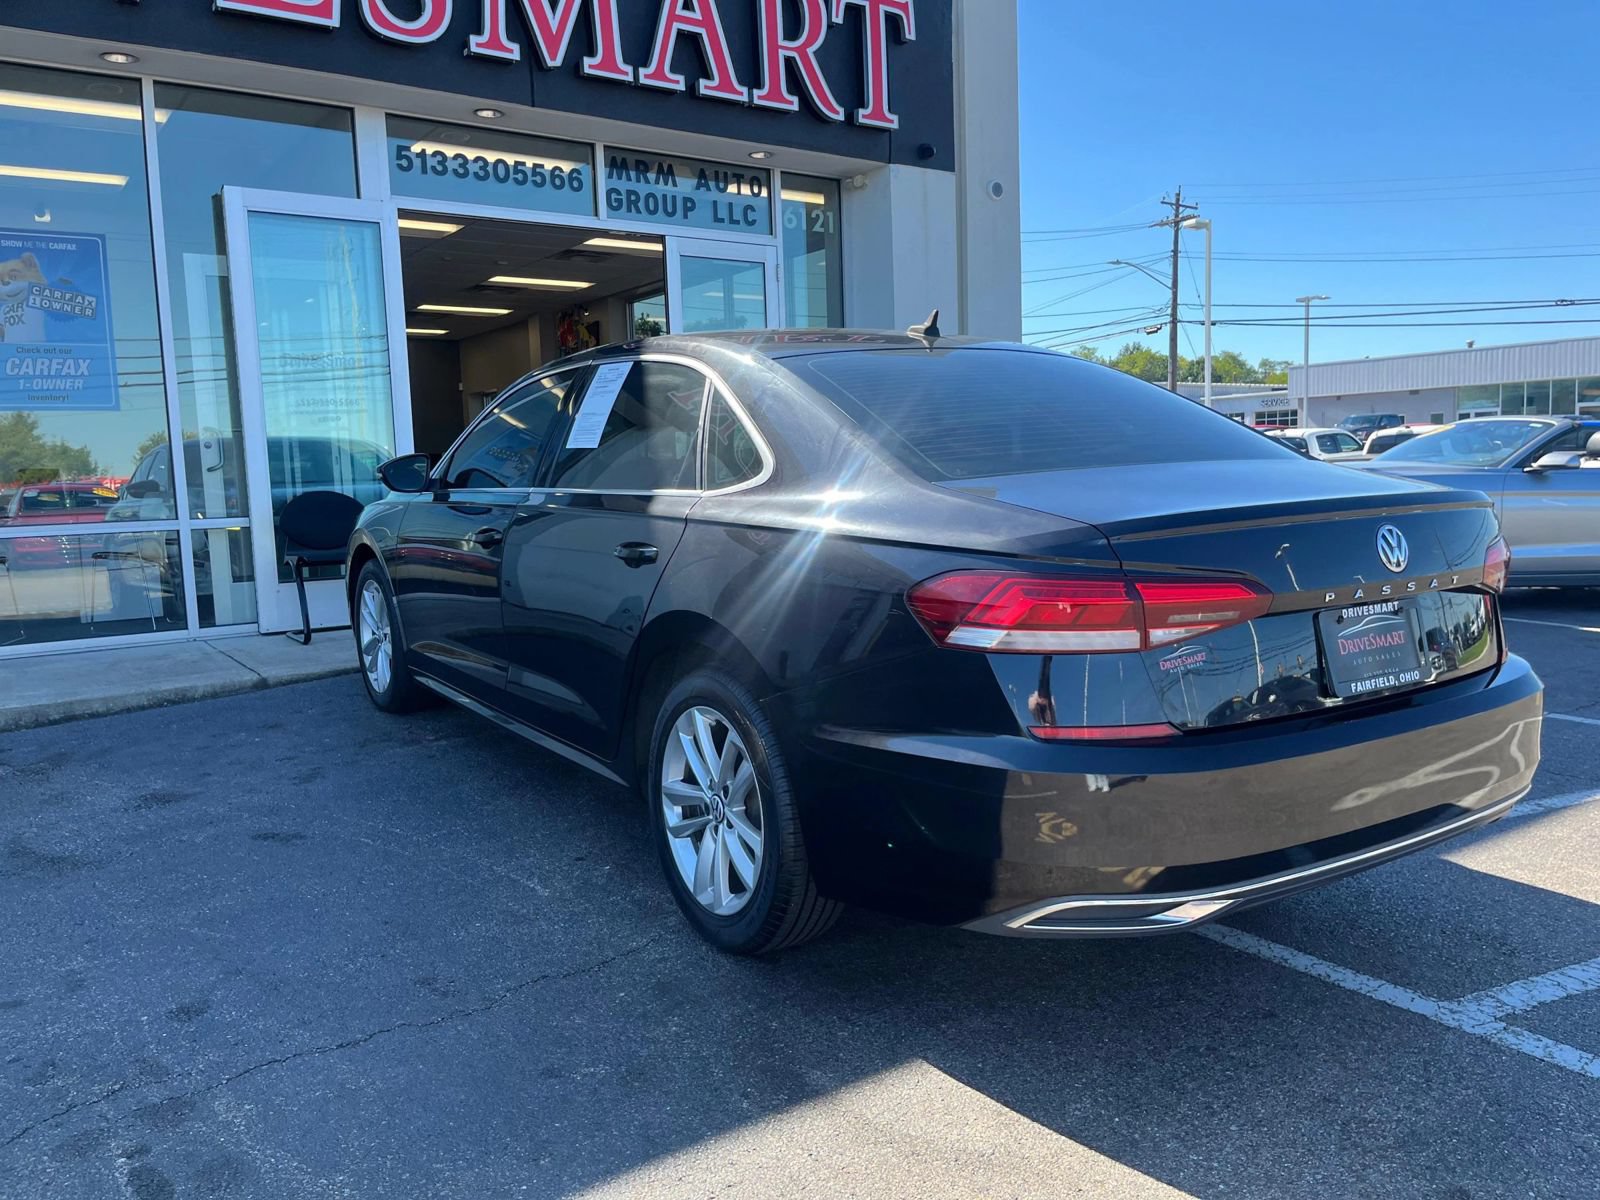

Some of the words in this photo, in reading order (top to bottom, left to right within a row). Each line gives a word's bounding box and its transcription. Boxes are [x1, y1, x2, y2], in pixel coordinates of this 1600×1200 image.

[395, 144, 584, 192] 5133305566
[607, 155, 678, 188] MRM
[695, 167, 763, 198] AUTO
[605, 187, 697, 220] GROUP
[712, 200, 758, 226] LLC
[783, 206, 834, 233] 6121
[48, 241, 77, 251] CARFAX
[32, 286, 96, 307] CARFAX
[3, 302, 25, 316] CAR
[42, 299, 94, 318] OWNER
[3, 313, 26, 327] FOX
[16, 346, 41, 354] Check
[43, 347, 57, 355] out
[6, 357, 91, 377] CARFAX
[1324, 575, 1460, 602] PASSAT
[1341, 601, 1400, 619] DRIVESMART
[1350, 674, 1399, 694] FAIRFIELD,
[1399, 670, 1421, 682] OHIO
